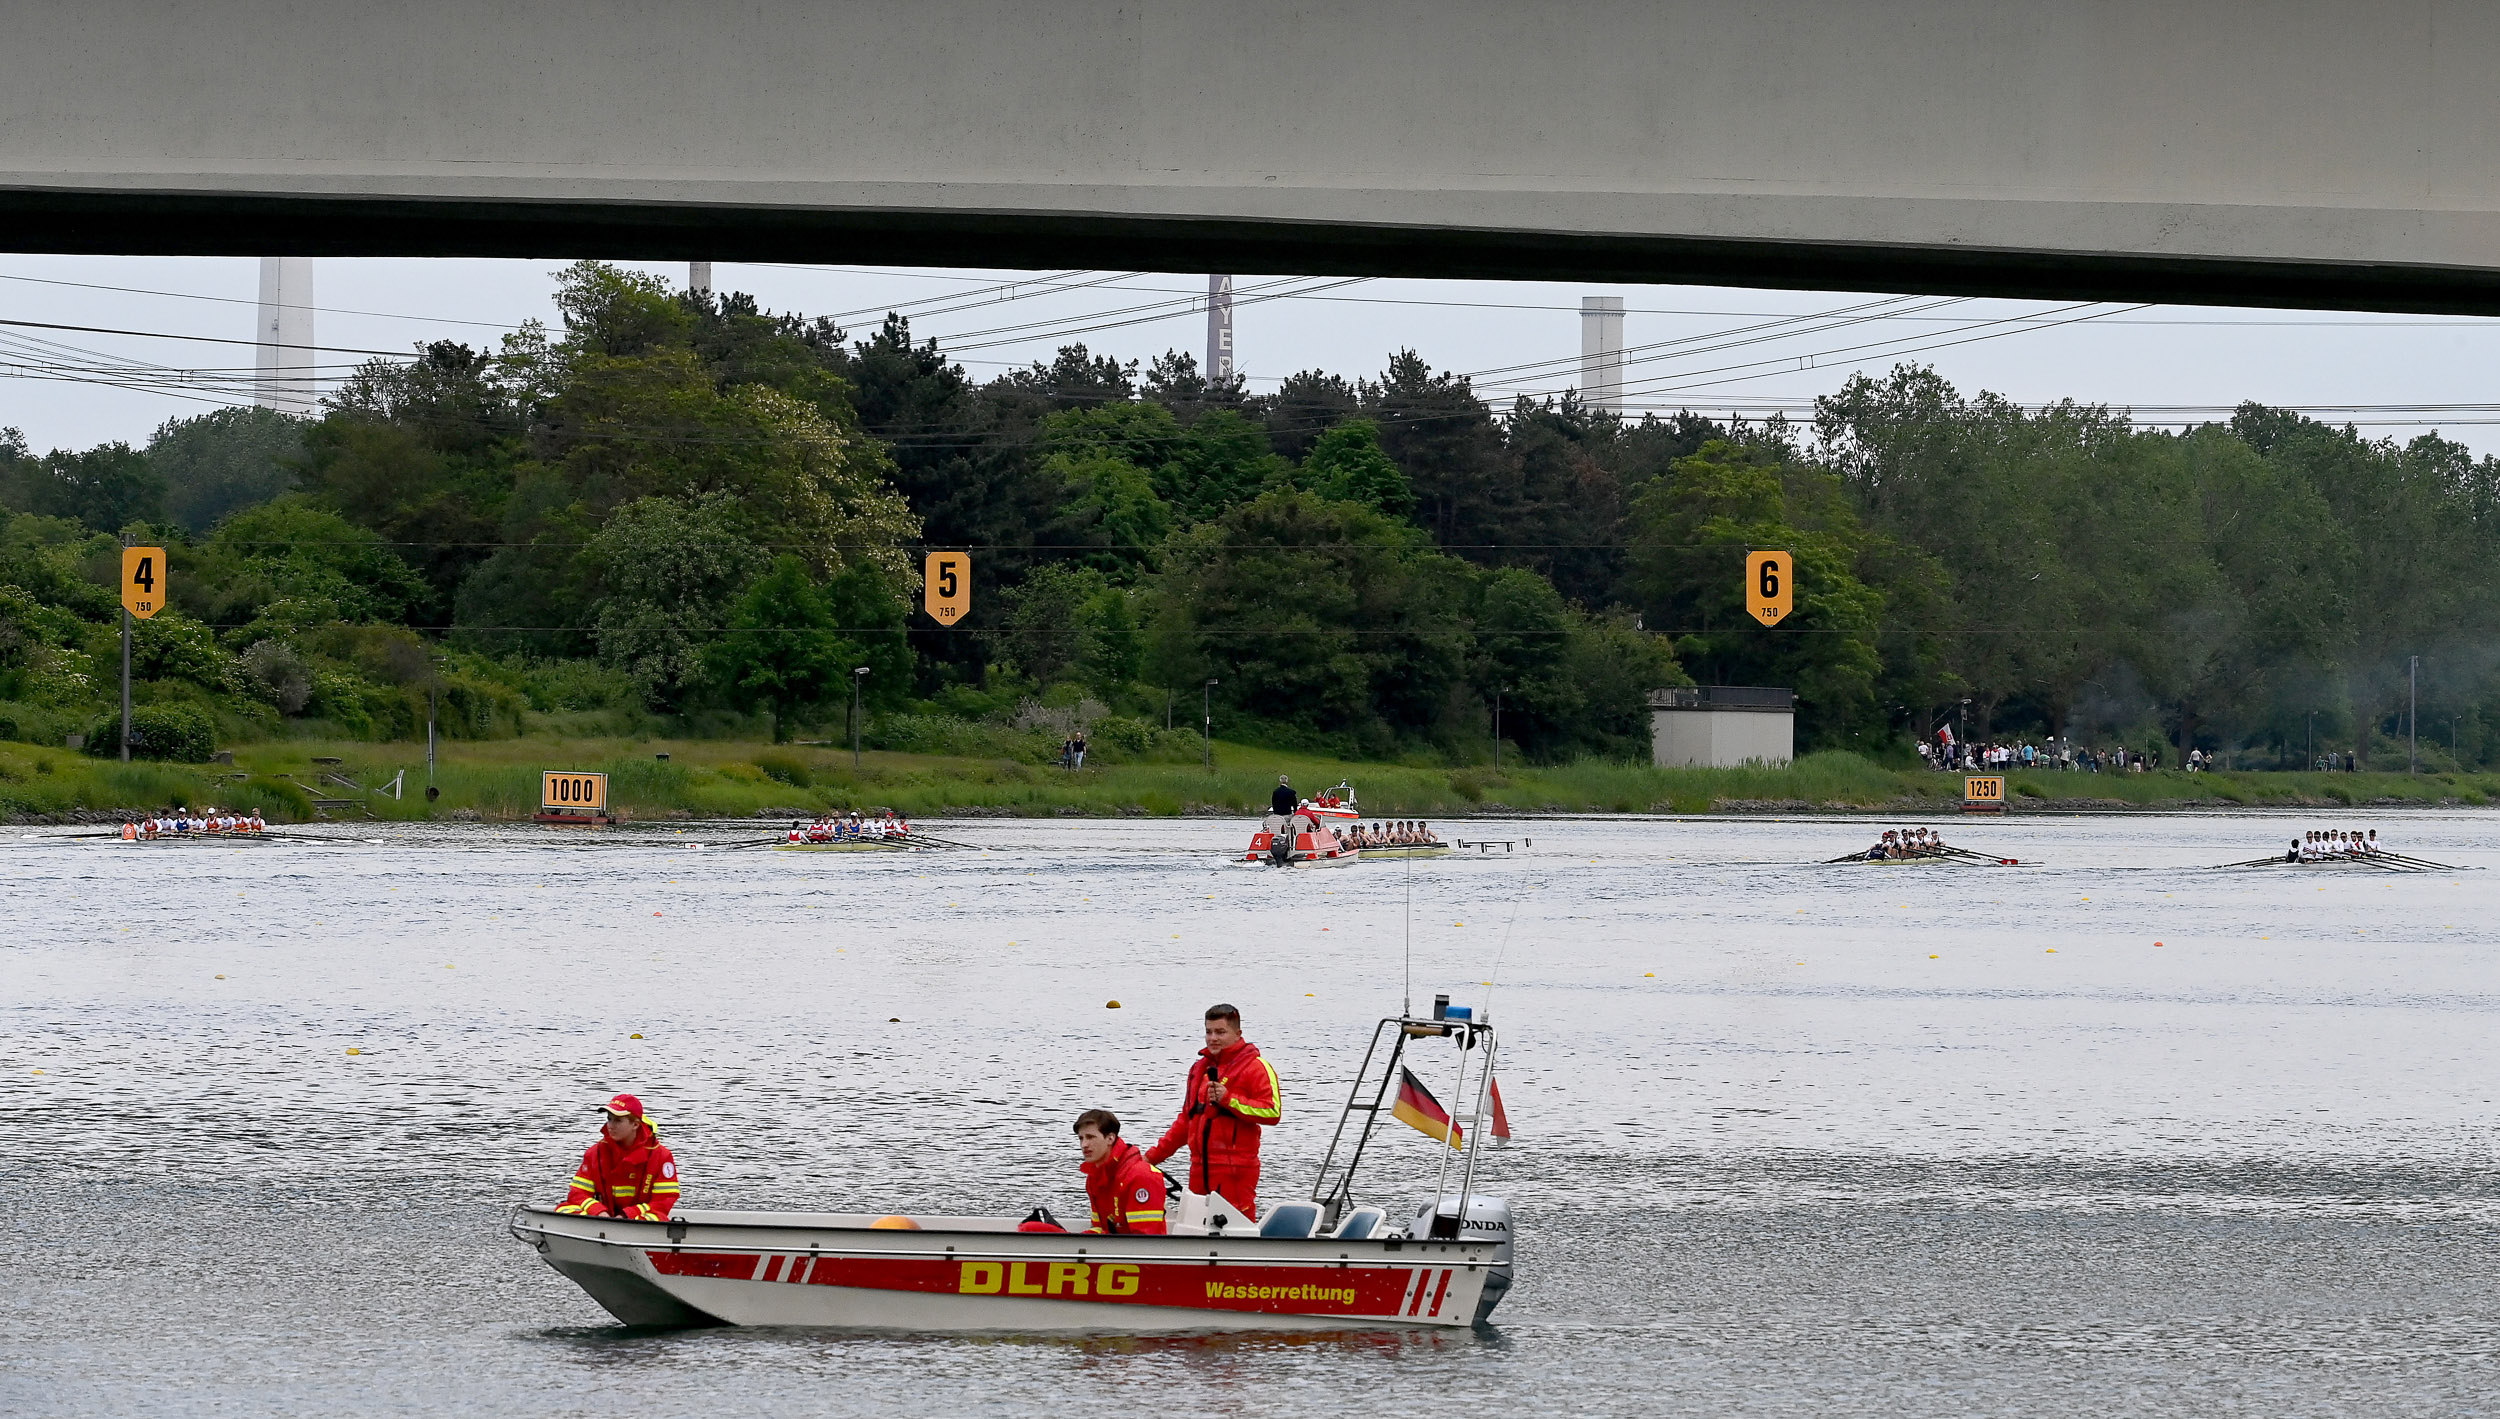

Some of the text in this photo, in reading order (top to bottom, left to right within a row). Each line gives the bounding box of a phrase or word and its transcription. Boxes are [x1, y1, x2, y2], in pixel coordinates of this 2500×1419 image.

[1218, 276, 1232, 378] AYER
[133, 557, 155, 593] 4
[938, 561, 958, 598] 5
[1760, 560, 1779, 598] 6
[135, 601, 152, 612] 750
[939, 607, 956, 617] 750
[1761, 607, 1778, 617] 750
[551, 778, 593, 802] 1000
[1970, 780, 1997, 797] 1250
[1254, 837, 1262, 847] 4
[1461, 1219, 1507, 1232] ONDA
[959, 1262, 1140, 1296] DLRG
[1205, 1281, 1356, 1305] Wasserrettung
